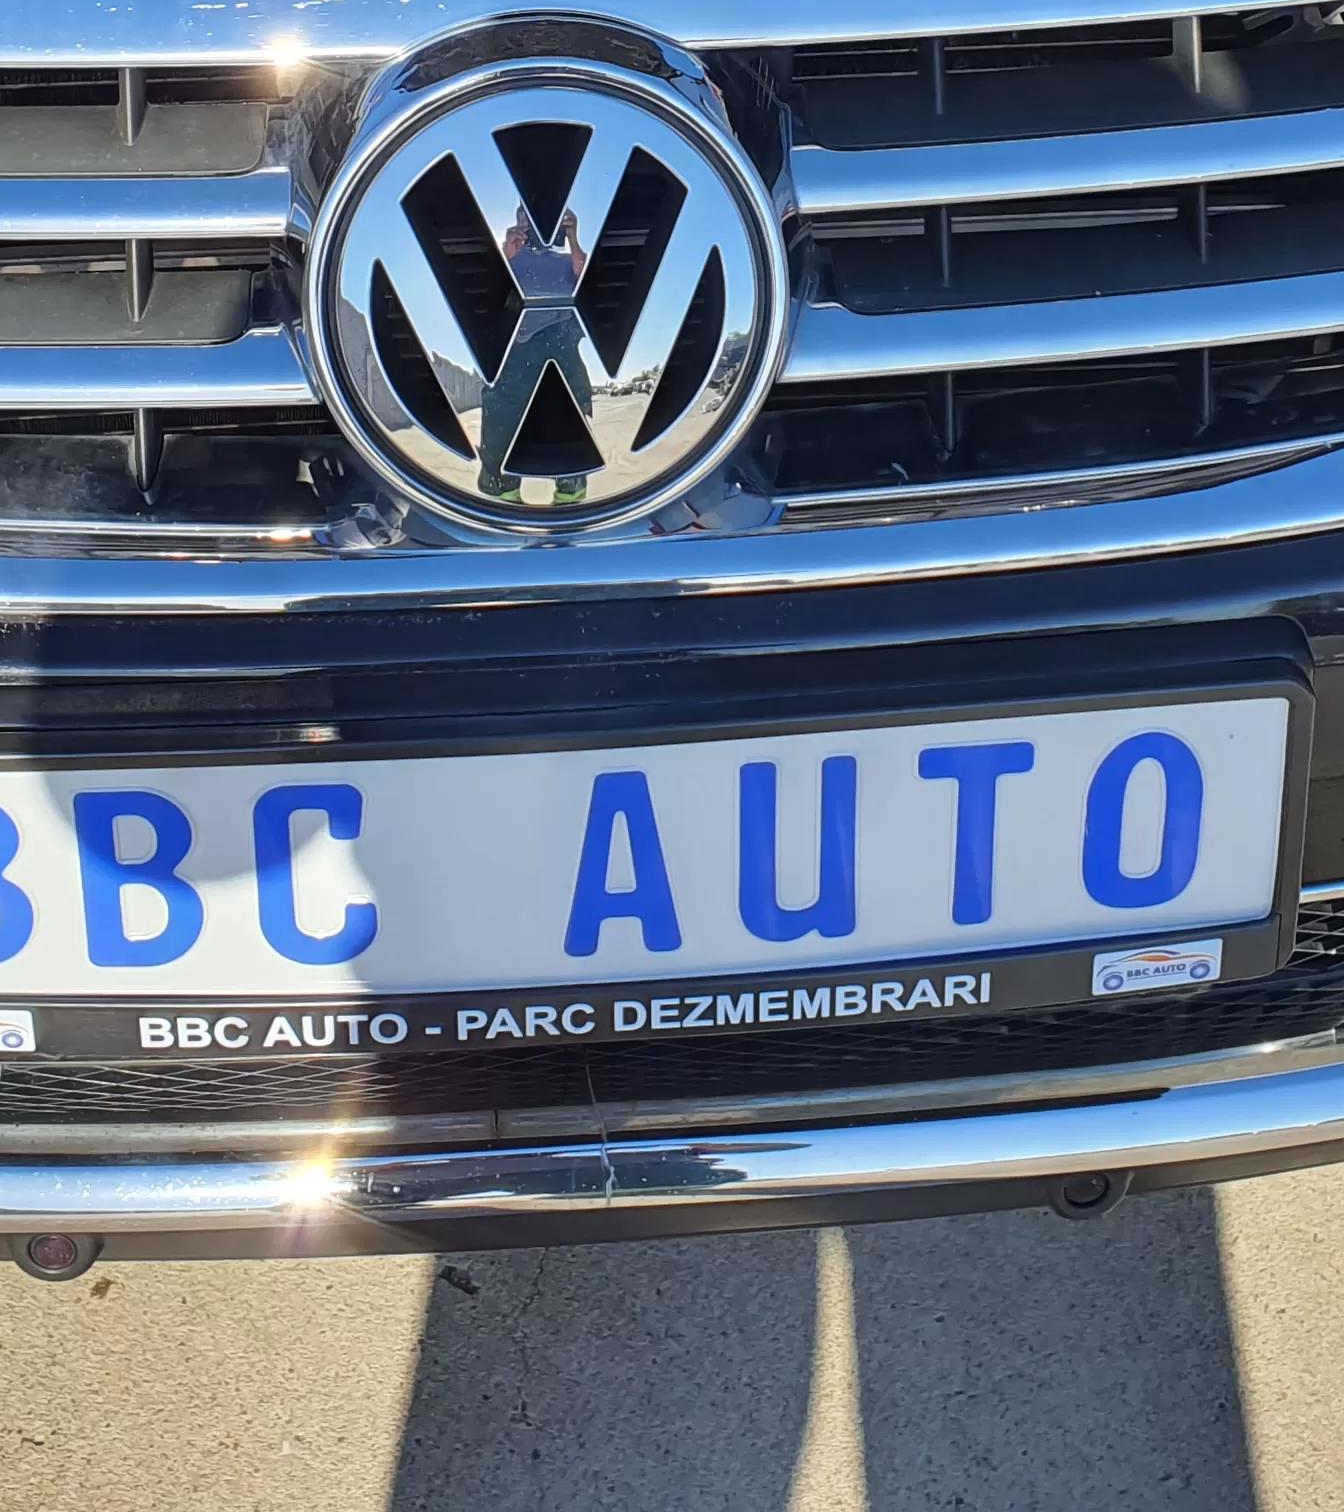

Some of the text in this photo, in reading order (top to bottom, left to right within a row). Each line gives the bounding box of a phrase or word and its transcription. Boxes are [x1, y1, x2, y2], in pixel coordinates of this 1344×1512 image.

[339, 86, 756, 508] VW
[563, 730, 1206, 958] AUTO
[138, 1015, 250, 1050] BBC
[261, 1013, 409, 1049] AUTO
[456, 1002, 597, 1043] PARC
[612, 971, 992, 1033] DEZMEMBRARI
[1126, 963, 1187, 978] BBC AUTO
